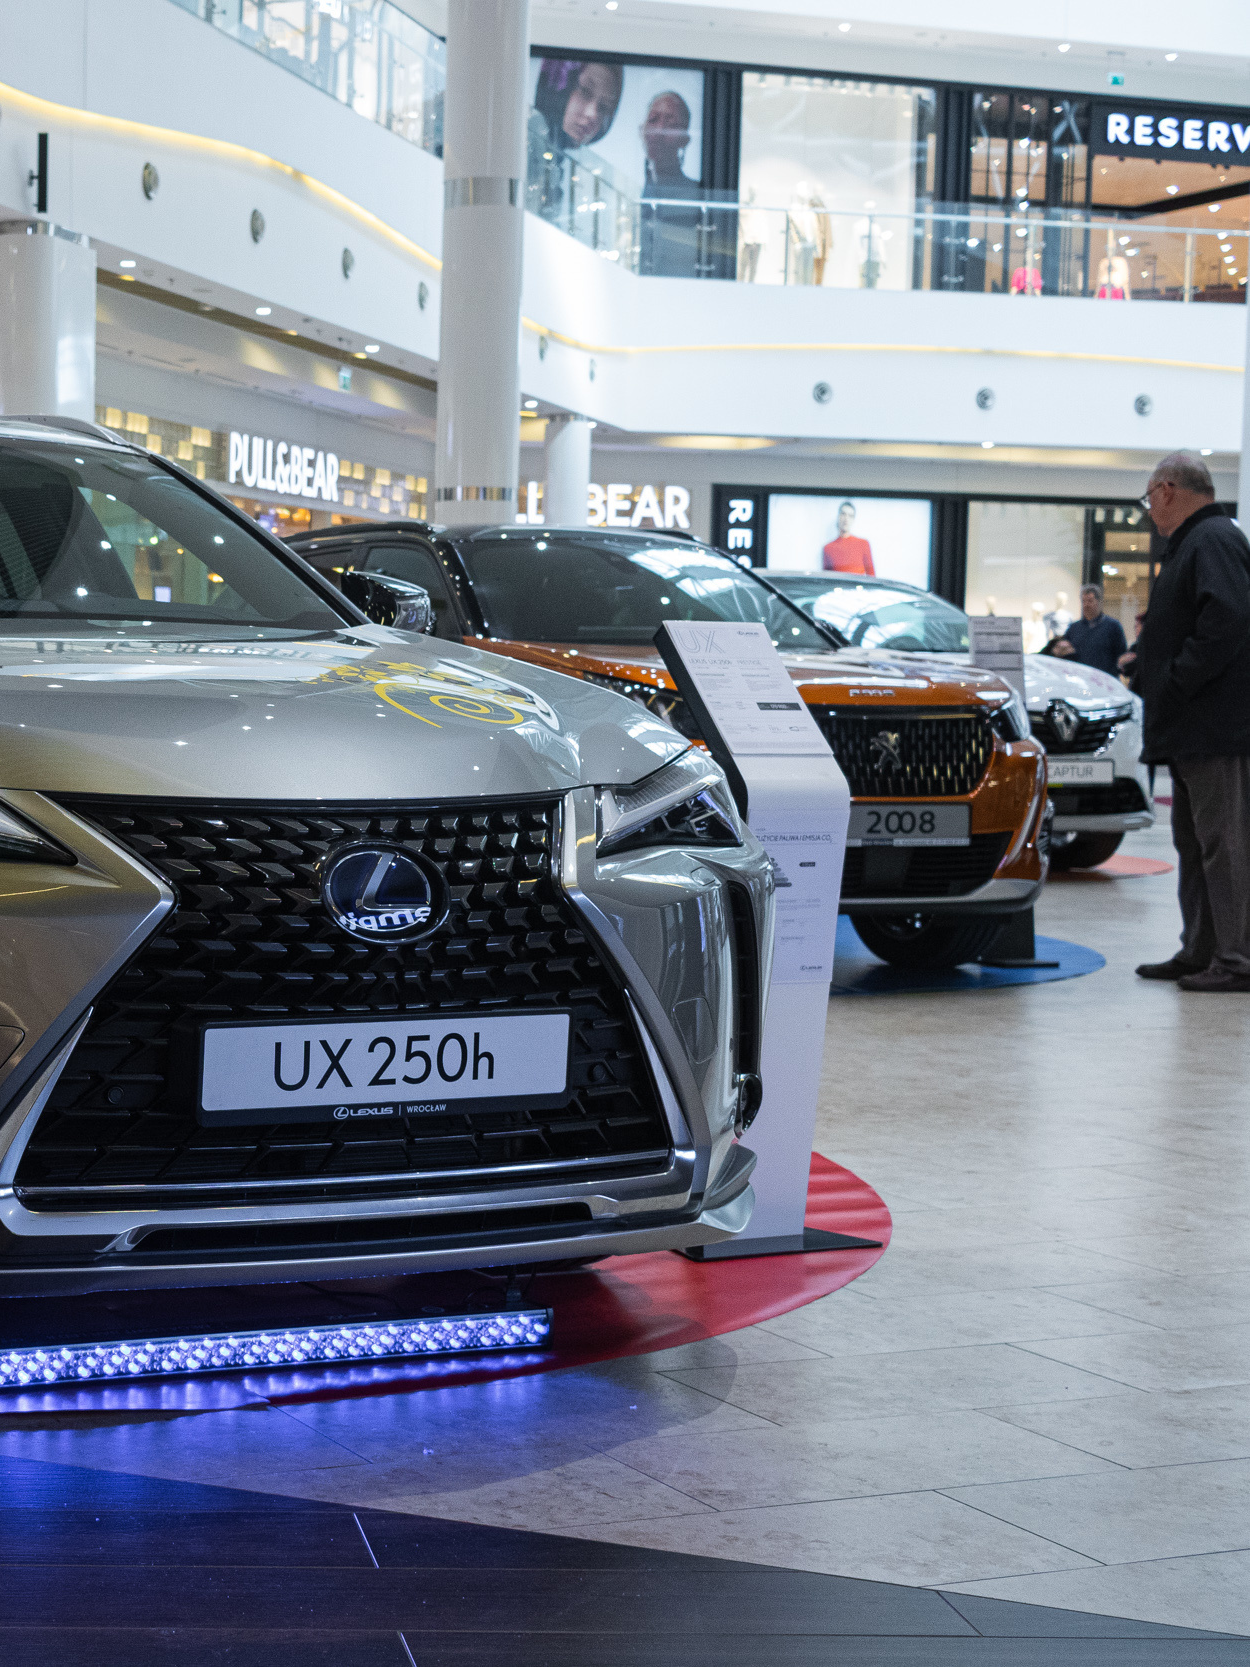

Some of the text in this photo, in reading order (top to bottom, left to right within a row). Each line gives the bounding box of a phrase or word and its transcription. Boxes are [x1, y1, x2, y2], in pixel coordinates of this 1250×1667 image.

[229, 431, 339, 502] PULL&BEAR
[673, 629, 725, 653] UX
[866, 810, 936, 834] 2008
[274, 1032, 494, 1091] UX 250h
[350, 1104, 447, 1116] LEXUS WROCŁAW
